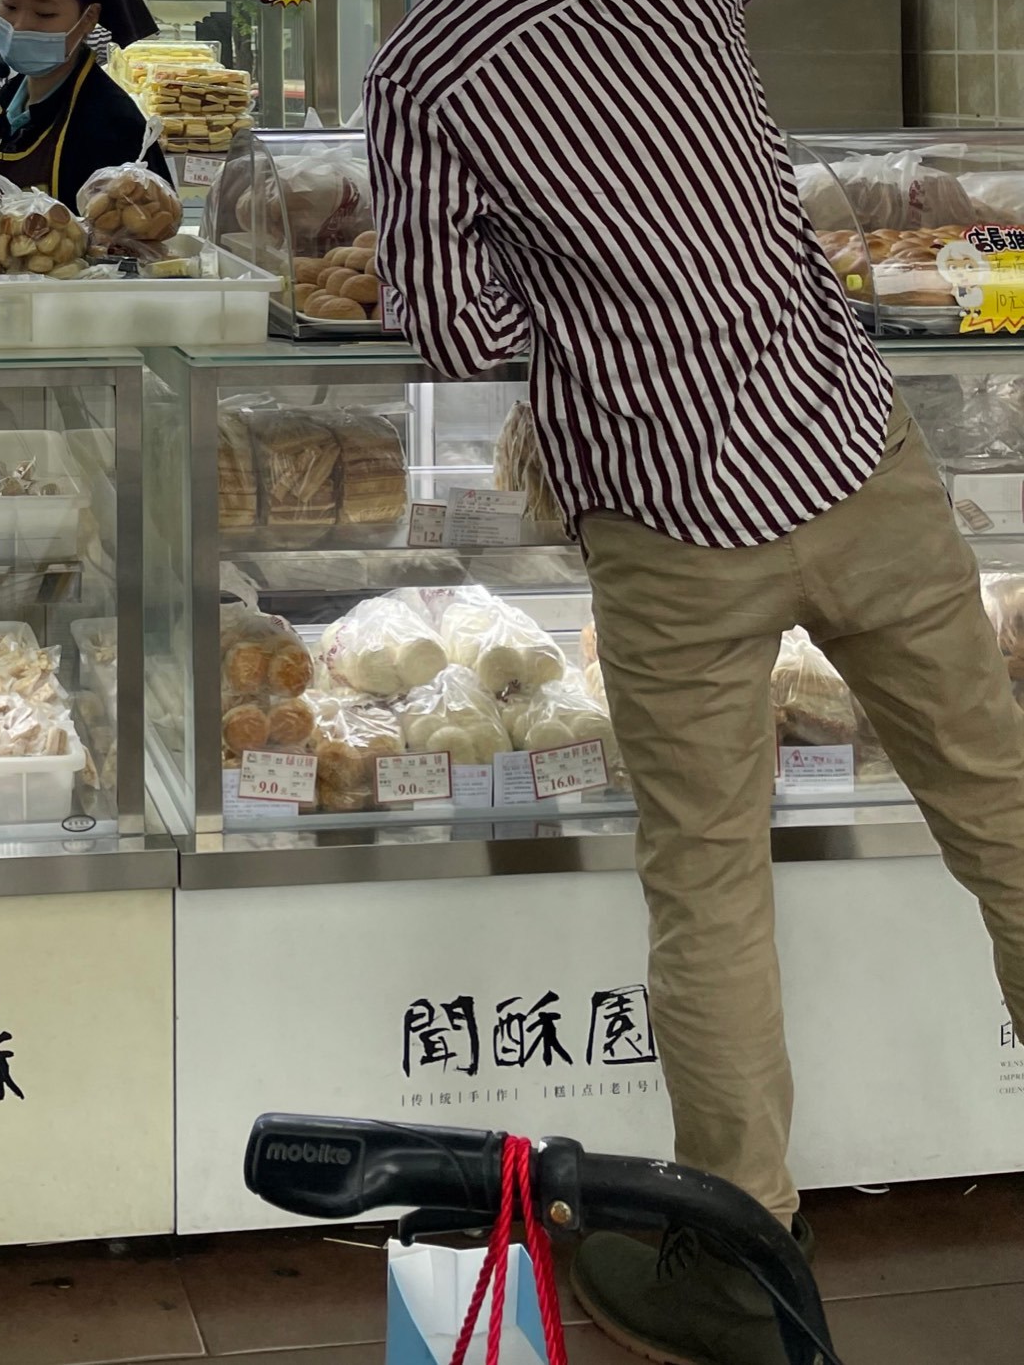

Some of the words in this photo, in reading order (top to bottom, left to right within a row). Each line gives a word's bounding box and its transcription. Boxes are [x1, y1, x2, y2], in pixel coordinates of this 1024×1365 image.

[402, 984, 660, 1078] 聞酥園
[265, 1141, 353, 1165] mobike
